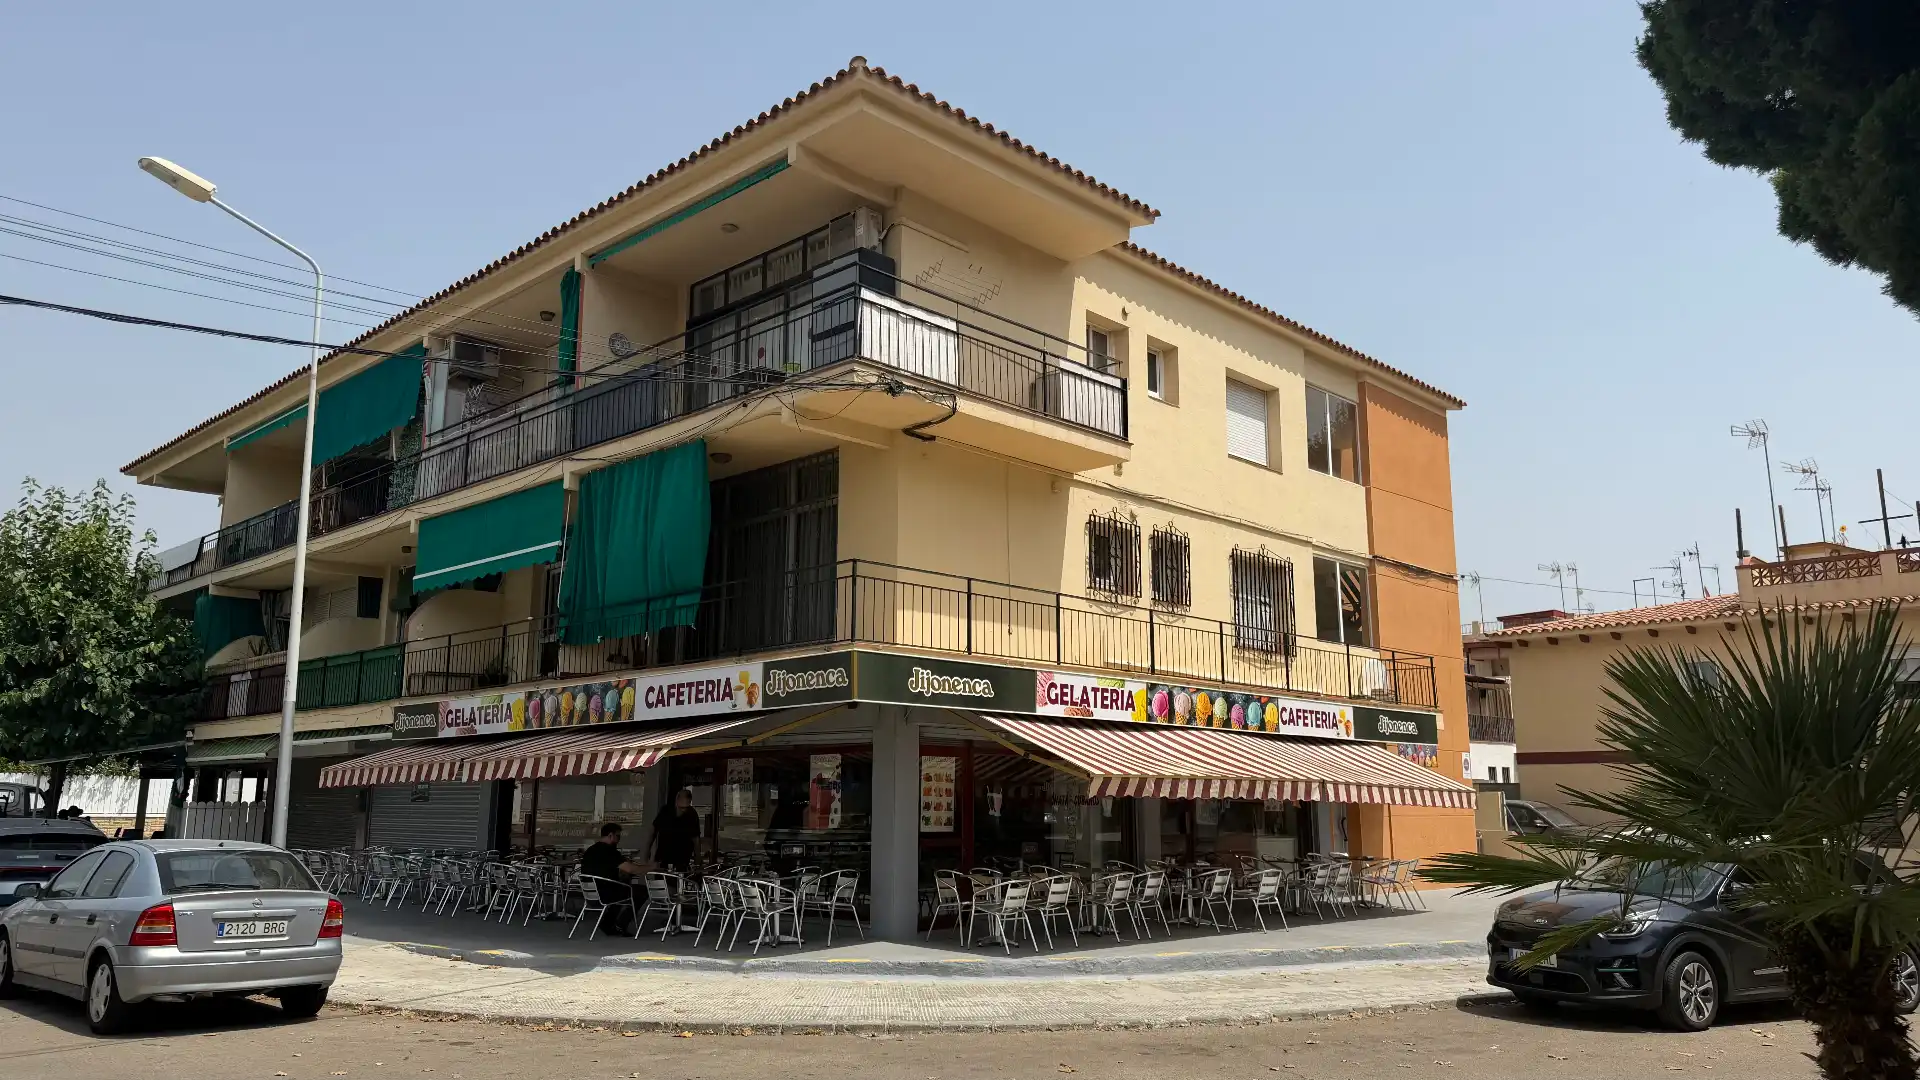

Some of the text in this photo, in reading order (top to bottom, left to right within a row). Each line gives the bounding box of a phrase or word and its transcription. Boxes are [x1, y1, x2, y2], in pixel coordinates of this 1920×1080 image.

[645, 677, 734, 709] CAFETERIA
[766, 667, 849, 697] Jijonenca
[908, 667, 995, 698] Jijonenca
[1046, 681, 1137, 712] GELATERIA
[395, 712, 437, 732] Jijonenca
[445, 702, 514, 728] GELATERIA
[1280, 706, 1339, 731] CAFETERIA
[1377, 715, 1419, 735] Jijonenca
[225, 922, 286, 935] 2120 BRG
